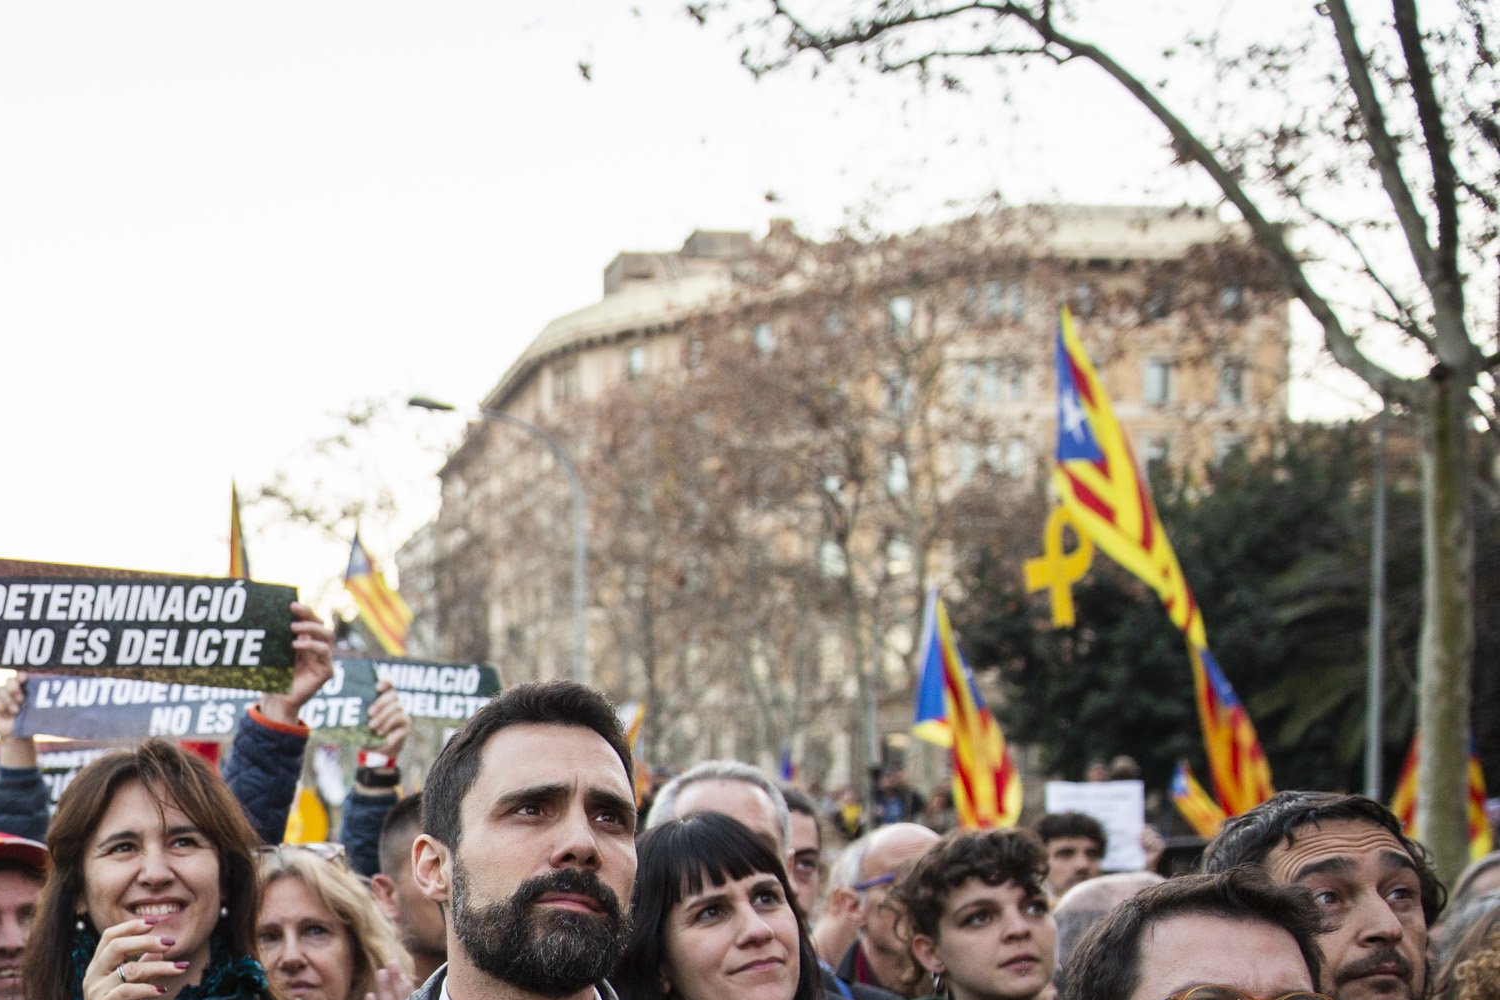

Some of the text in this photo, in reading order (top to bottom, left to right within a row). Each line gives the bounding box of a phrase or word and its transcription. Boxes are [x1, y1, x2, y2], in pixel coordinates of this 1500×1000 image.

[0, 624, 266, 666] NO ÉS DELICTE
[151, 707, 192, 736] NO
[199, 702, 237, 735] ÉS
[399, 691, 491, 719] DELICT
